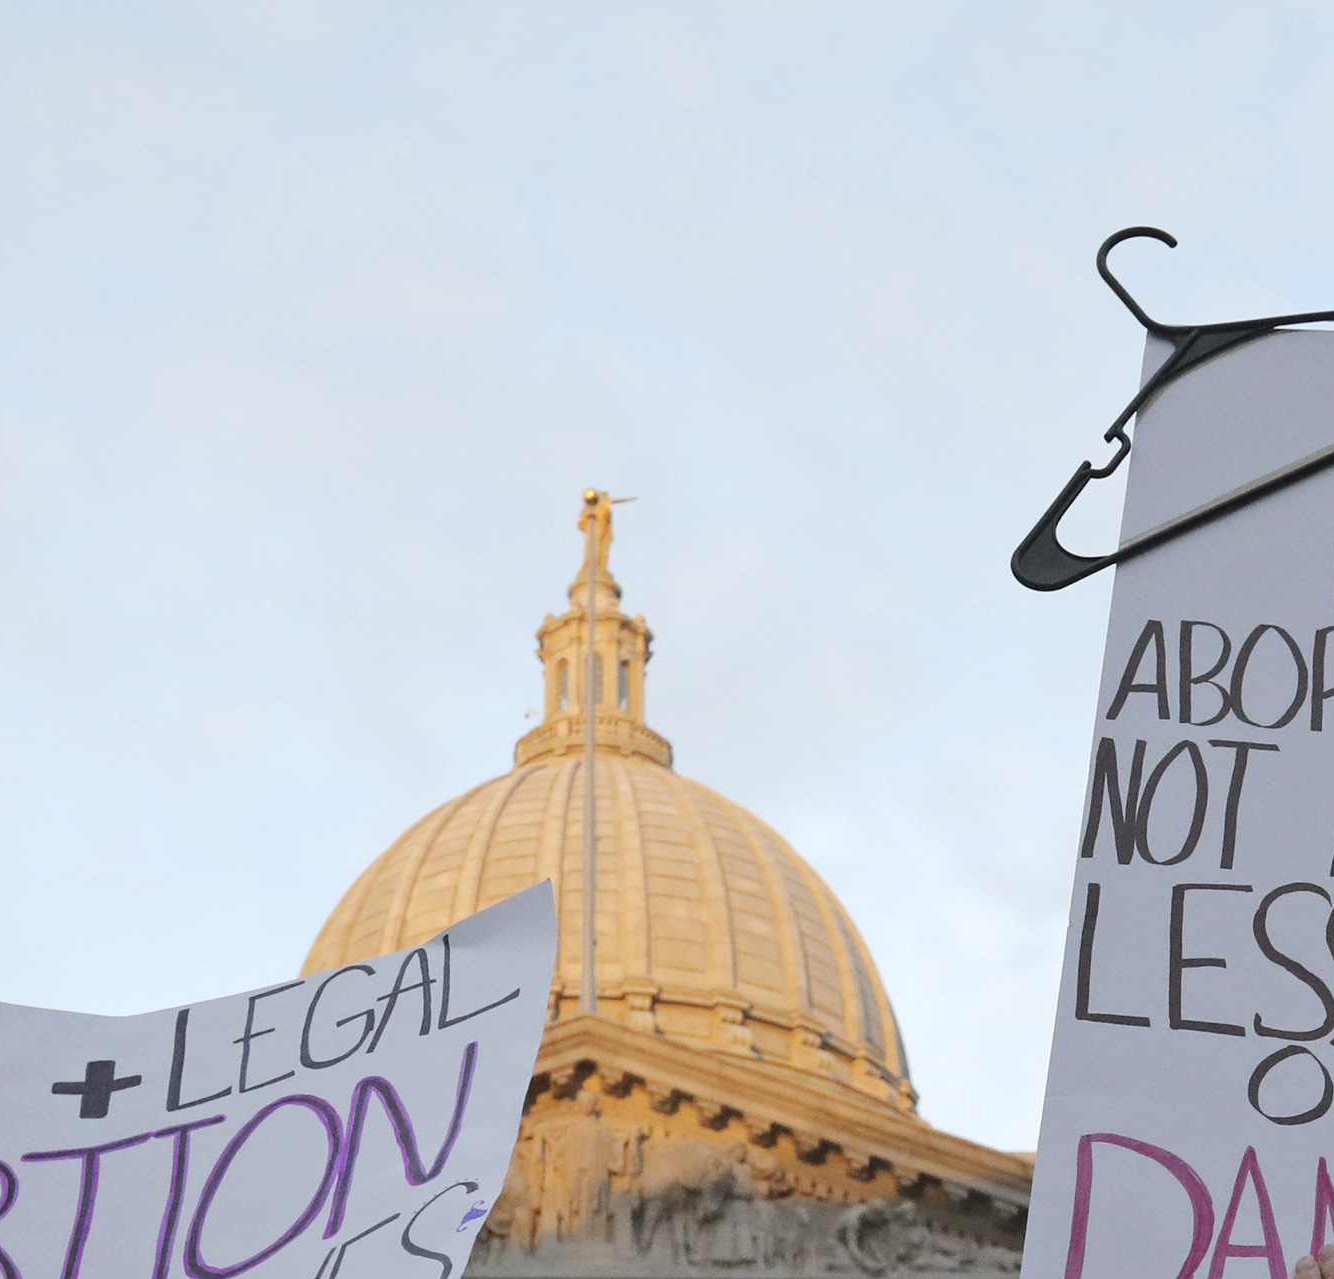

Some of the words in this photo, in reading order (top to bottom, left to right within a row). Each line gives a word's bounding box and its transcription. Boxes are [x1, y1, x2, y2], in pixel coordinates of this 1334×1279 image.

[1081, 737, 1280, 870] NOT
[51, 1060, 142, 1119] +
[165, 932, 520, 1112] LEGAL
